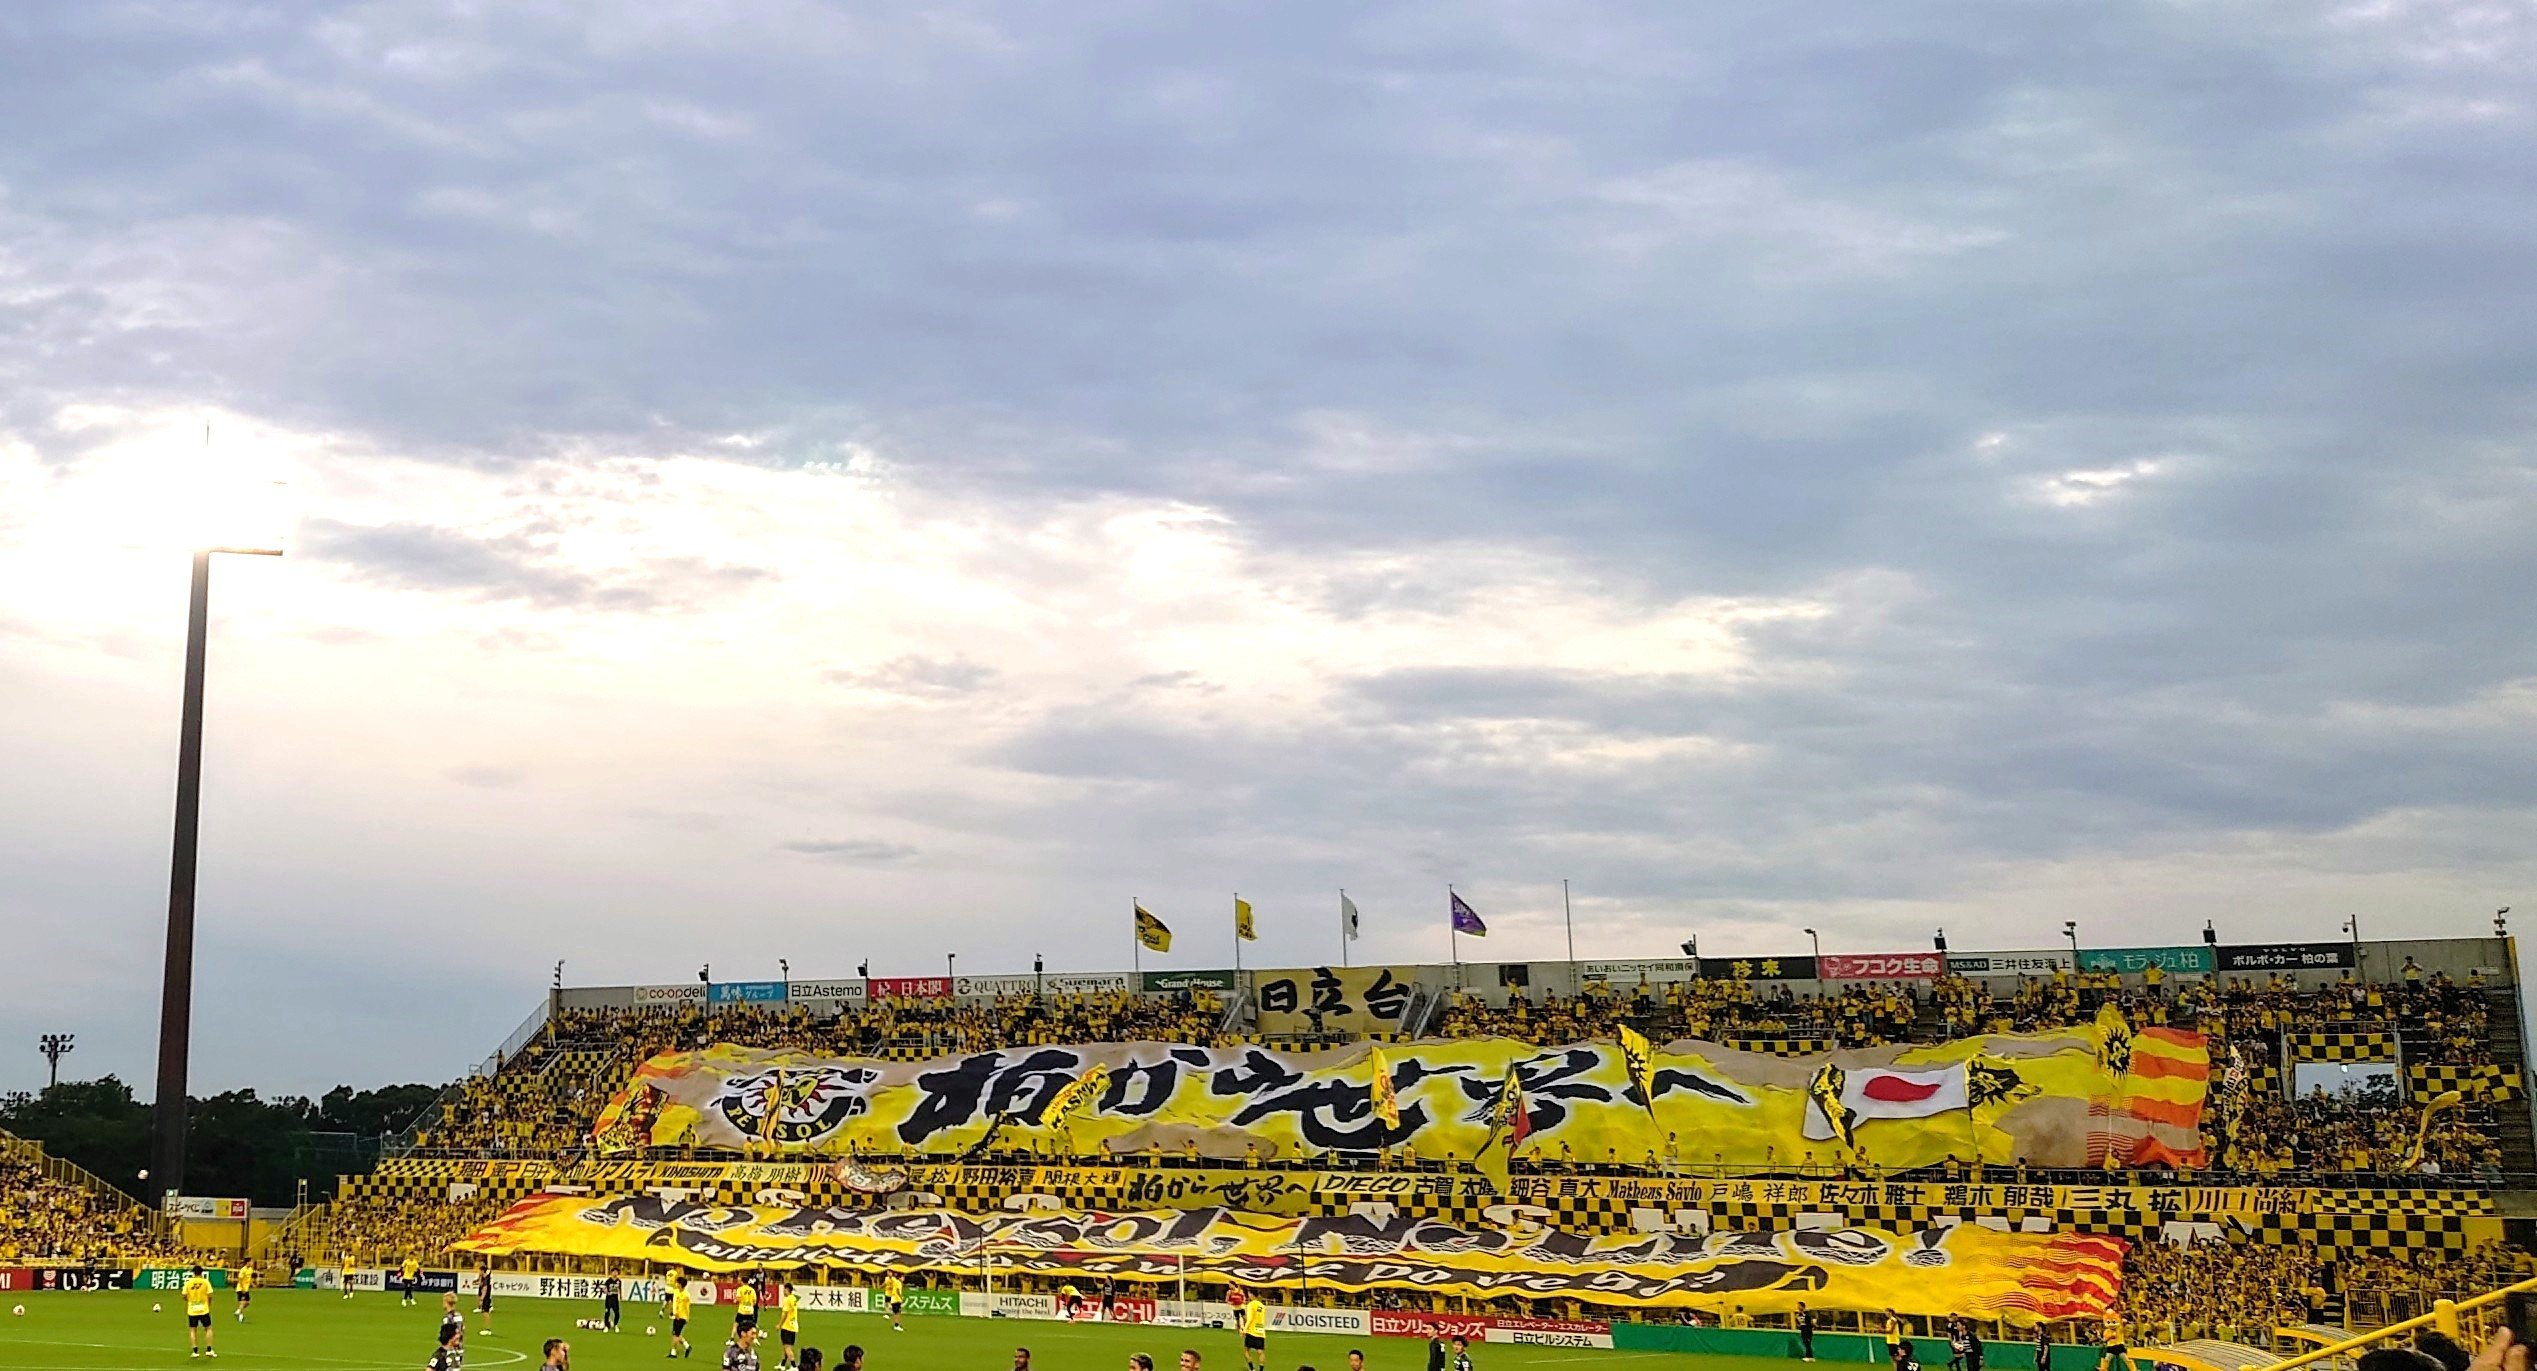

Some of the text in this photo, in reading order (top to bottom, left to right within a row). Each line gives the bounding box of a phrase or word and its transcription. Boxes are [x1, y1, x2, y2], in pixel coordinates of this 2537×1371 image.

[1852, 957, 1940, 975] フコク生命
[791, 984, 863, 997] 日立Astemo
[974, 979, 1037, 992] QUATTRO
[1260, 967, 1413, 1020] 日立台
[1128, 1172, 1308, 1207] 柏から世界へ
[1324, 1175, 1409, 1194] DIEGO
[1558, 1177, 1602, 1199] 真大
[1819, 1184, 1879, 1205] 佐々木
[2070, 1187, 2137, 1212] 三丸
[539, 1277, 608, 1299] 野村證券
[808, 1289, 863, 1308] 大林組
[874, 1293, 953, 1311] 日ステムズ
[999, 1296, 1049, 1309] HITACHI
[1287, 1312, 1361, 1330] LOGISTEED
[1372, 1316, 1486, 1338] 日立ソリュションズ
[1496, 1319, 1609, 1333] 日立エレベーター・エスカレーター
[1513, 1332, 1593, 1348] 日立ビルシステム
